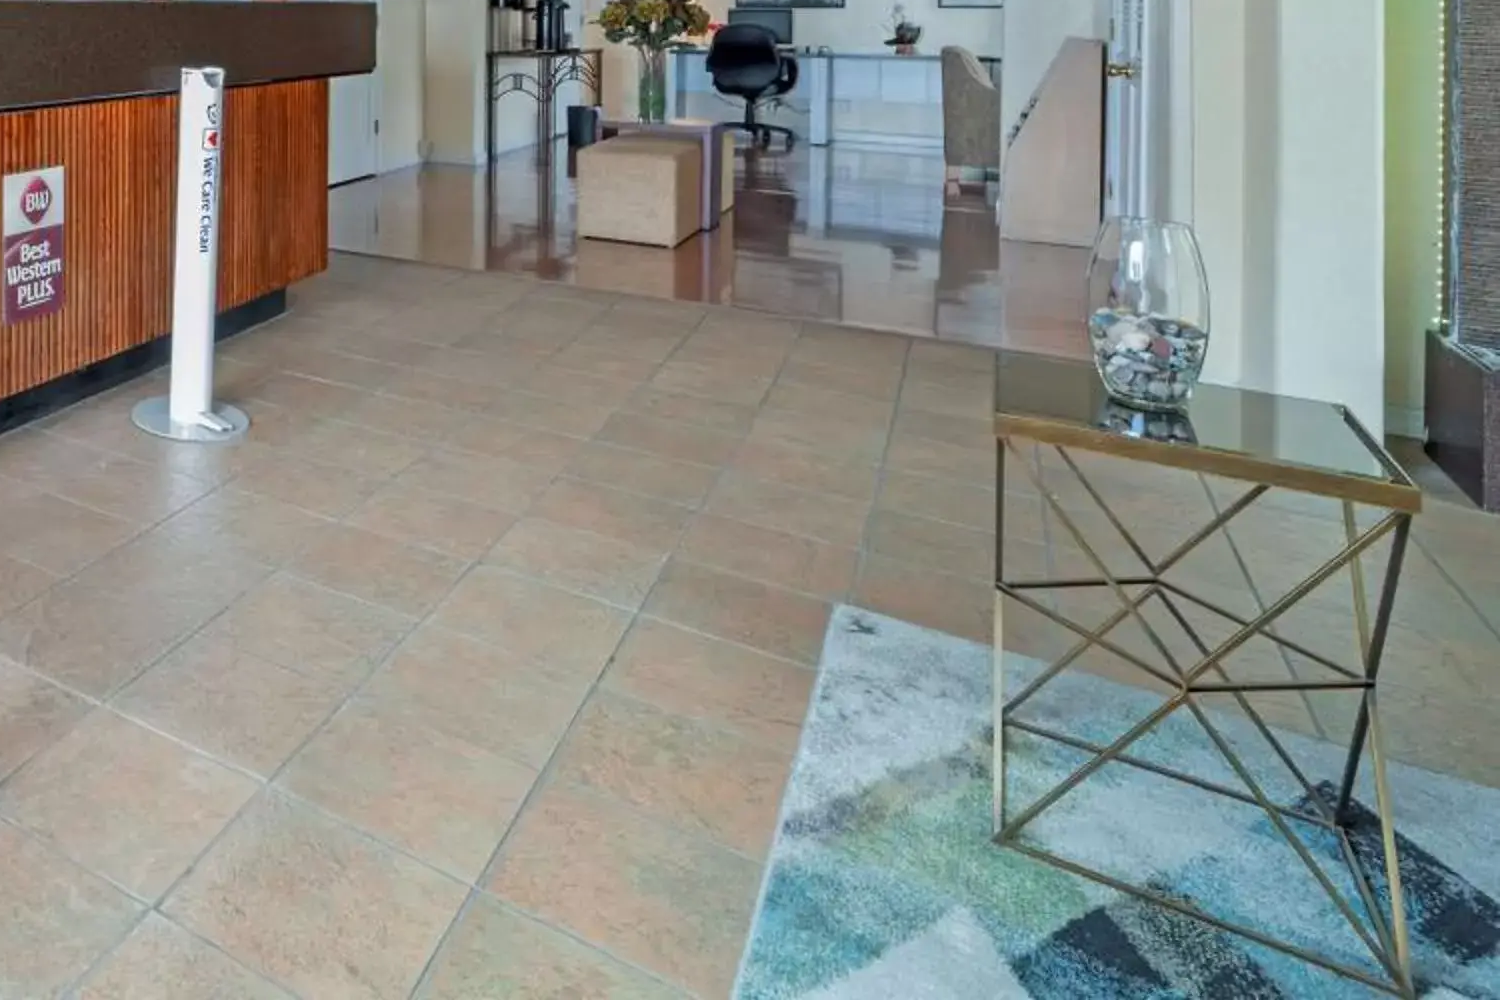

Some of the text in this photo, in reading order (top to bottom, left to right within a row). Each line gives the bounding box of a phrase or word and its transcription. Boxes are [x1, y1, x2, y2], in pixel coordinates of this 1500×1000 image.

[199, 157, 214, 253] We Care Clean
[20, 240, 50, 263] Best
[7, 258, 61, 286] Western
[17, 278, 54, 304] PLUS
